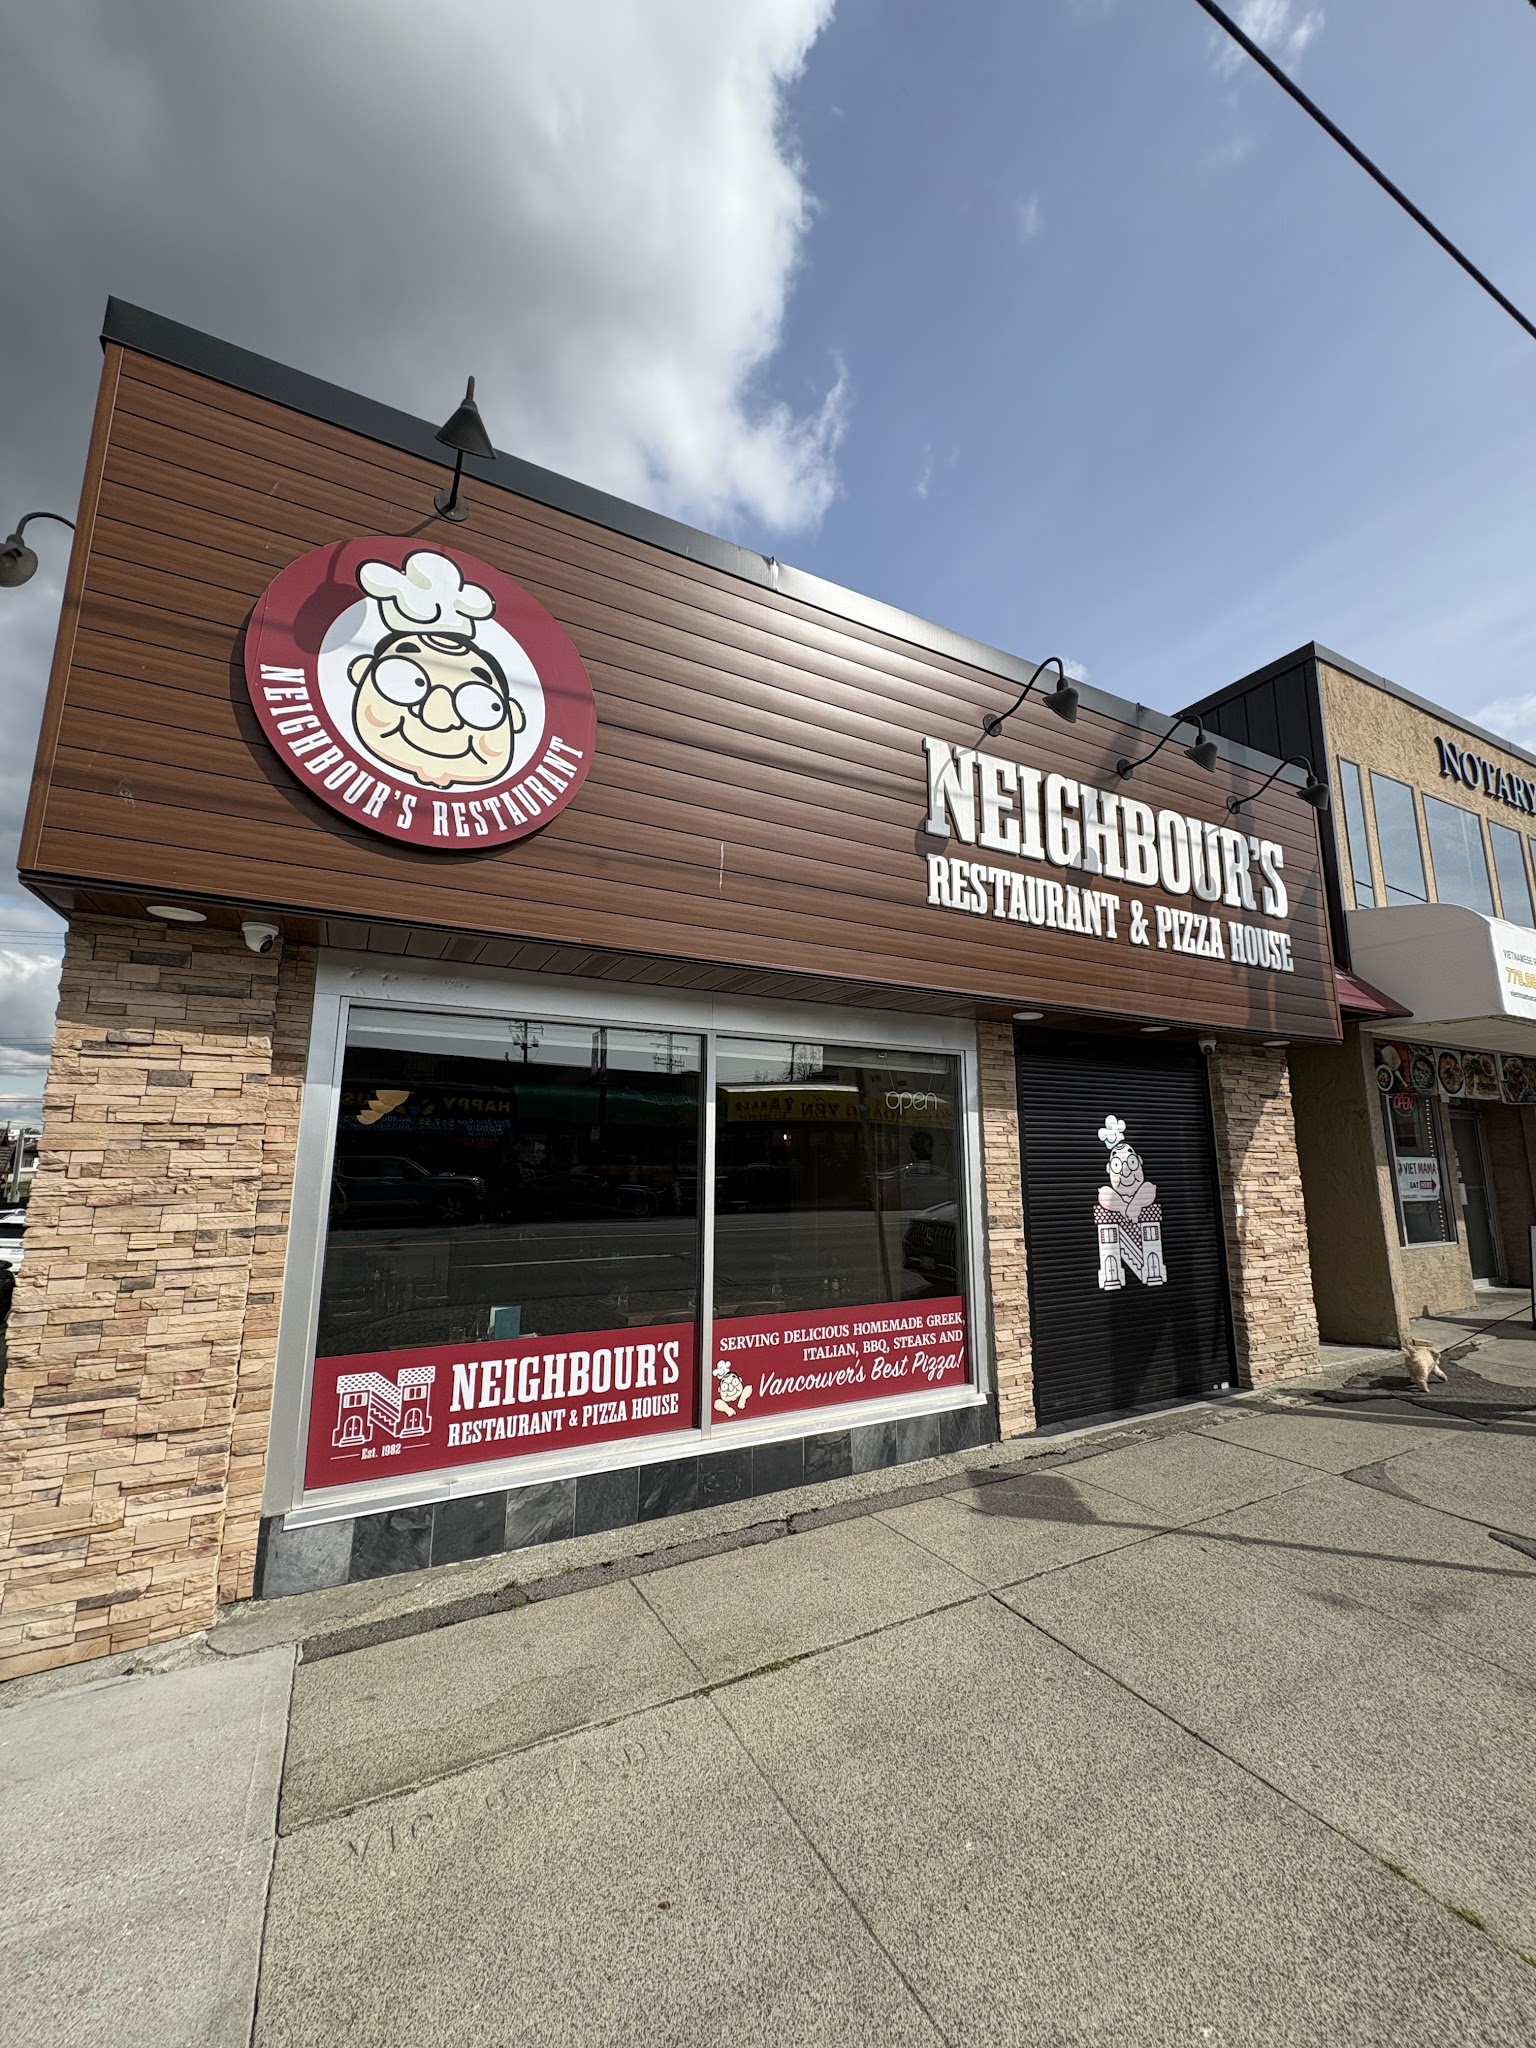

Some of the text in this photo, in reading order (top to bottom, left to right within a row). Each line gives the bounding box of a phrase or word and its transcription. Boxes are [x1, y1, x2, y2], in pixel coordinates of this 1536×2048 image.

[260, 663, 584, 838] NEIGHBOUR'S RESTAURANT
[1433, 736, 1536, 815] NOTARY
[923, 736, 1289, 919] NEIGHBOUR'S
[925, 853, 1295, 973] RESTAURANT & PIZZA HOUSE
[884, 1090, 938, 1116] open
[1394, 1095, 1413, 1110] OPEN
[1403, 1162, 1438, 1175] VIET MAMA
[1409, 1181, 1419, 1189] EAT
[719, 1312, 966, 1352] SERVING DELICIOUS HOMEMADE GREEK,
[803, 1329, 964, 1362] ITALIAN, BBQ, STEAKS AND
[450, 1340, 680, 1412] NEIGHBOUR'S
[758, 1346, 964, 1398] Vancouver's Best Pizza!
[447, 1393, 679, 1447] RESTAURANT & PIZZA HOUSE
[361, 1443, 402, 1460] Est. 1982
